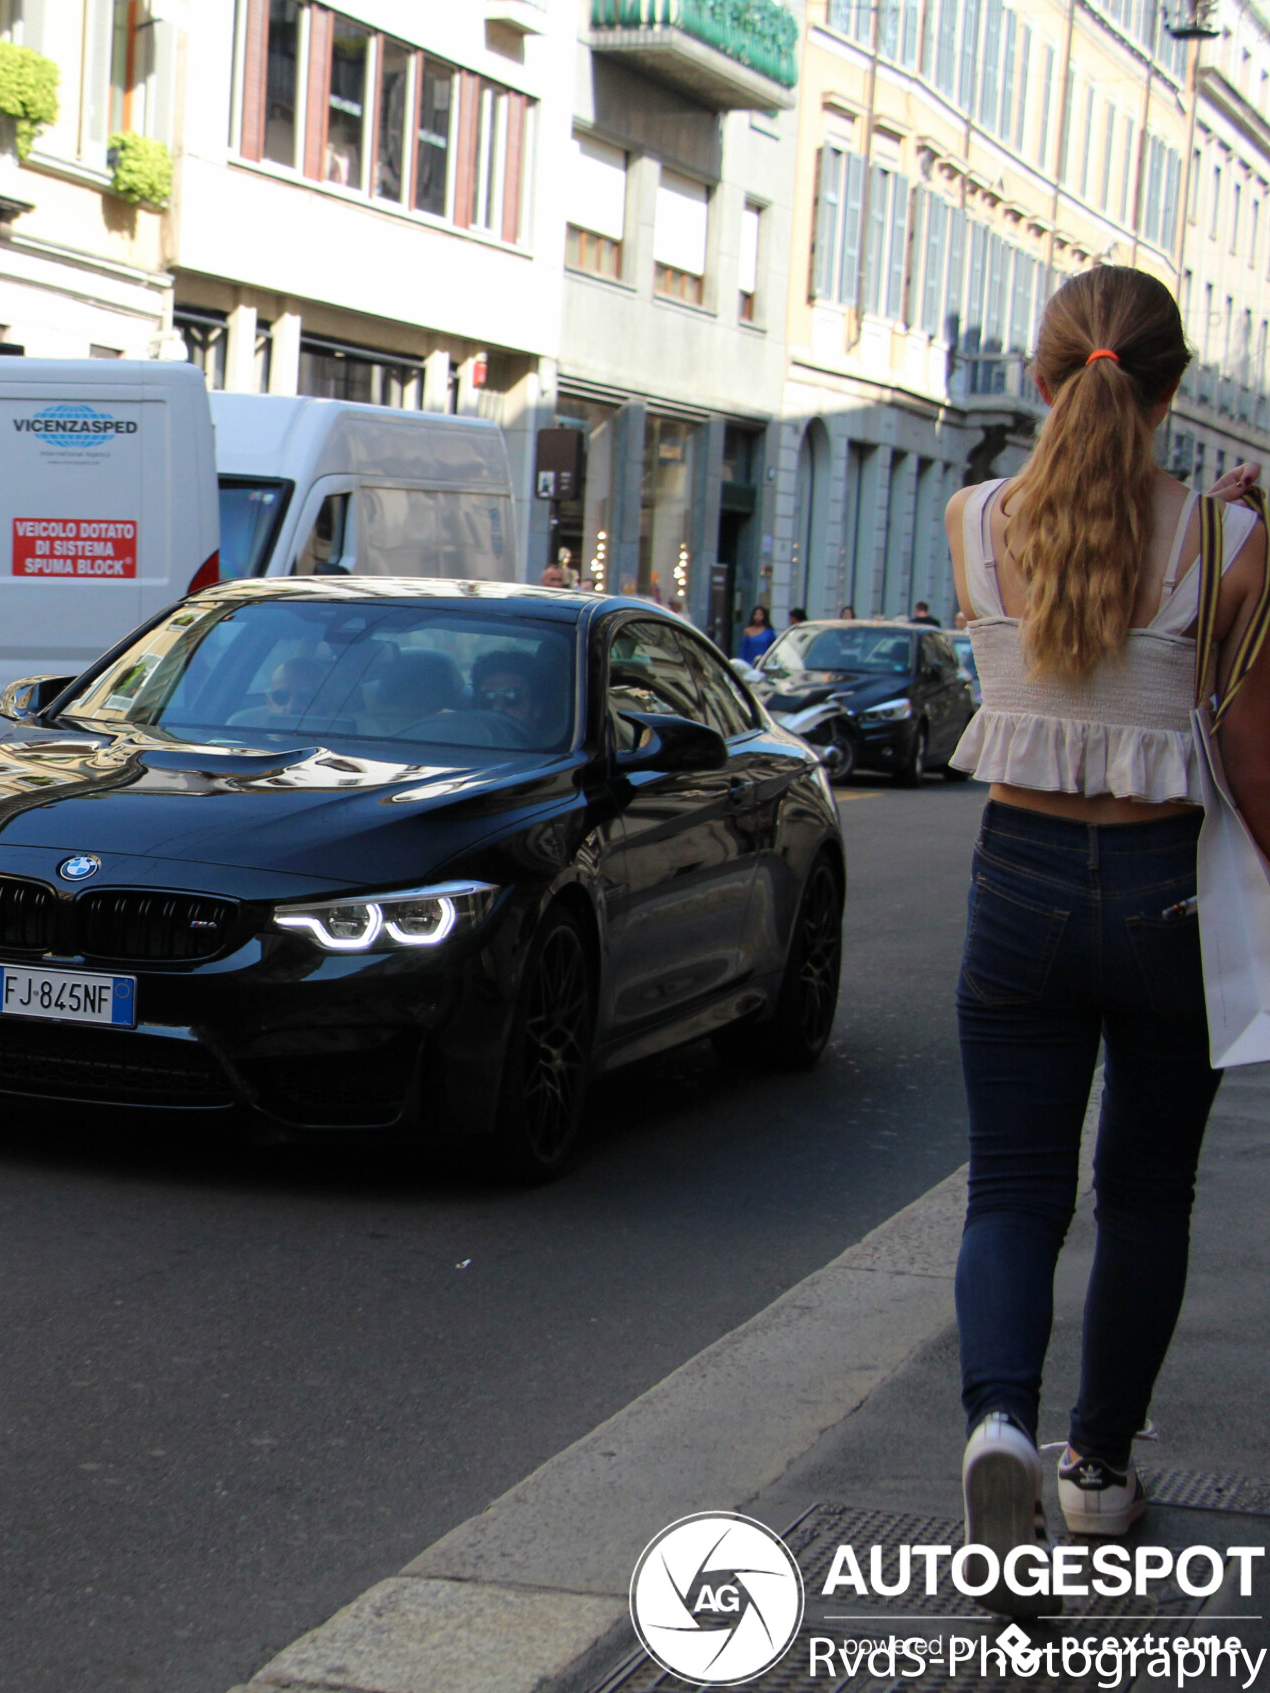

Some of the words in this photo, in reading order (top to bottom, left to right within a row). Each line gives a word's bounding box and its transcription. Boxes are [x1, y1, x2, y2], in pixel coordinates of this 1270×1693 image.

[13, 418, 138, 434] VICENZASPED
[15, 521, 77, 537] VEICOLO
[80, 523, 135, 539] DOTATO
[35, 540, 50, 555] DI
[53, 540, 115, 556] SISTEMA
[24, 558, 75, 574] SPUMA
[77, 558, 125, 575] BLOCK
